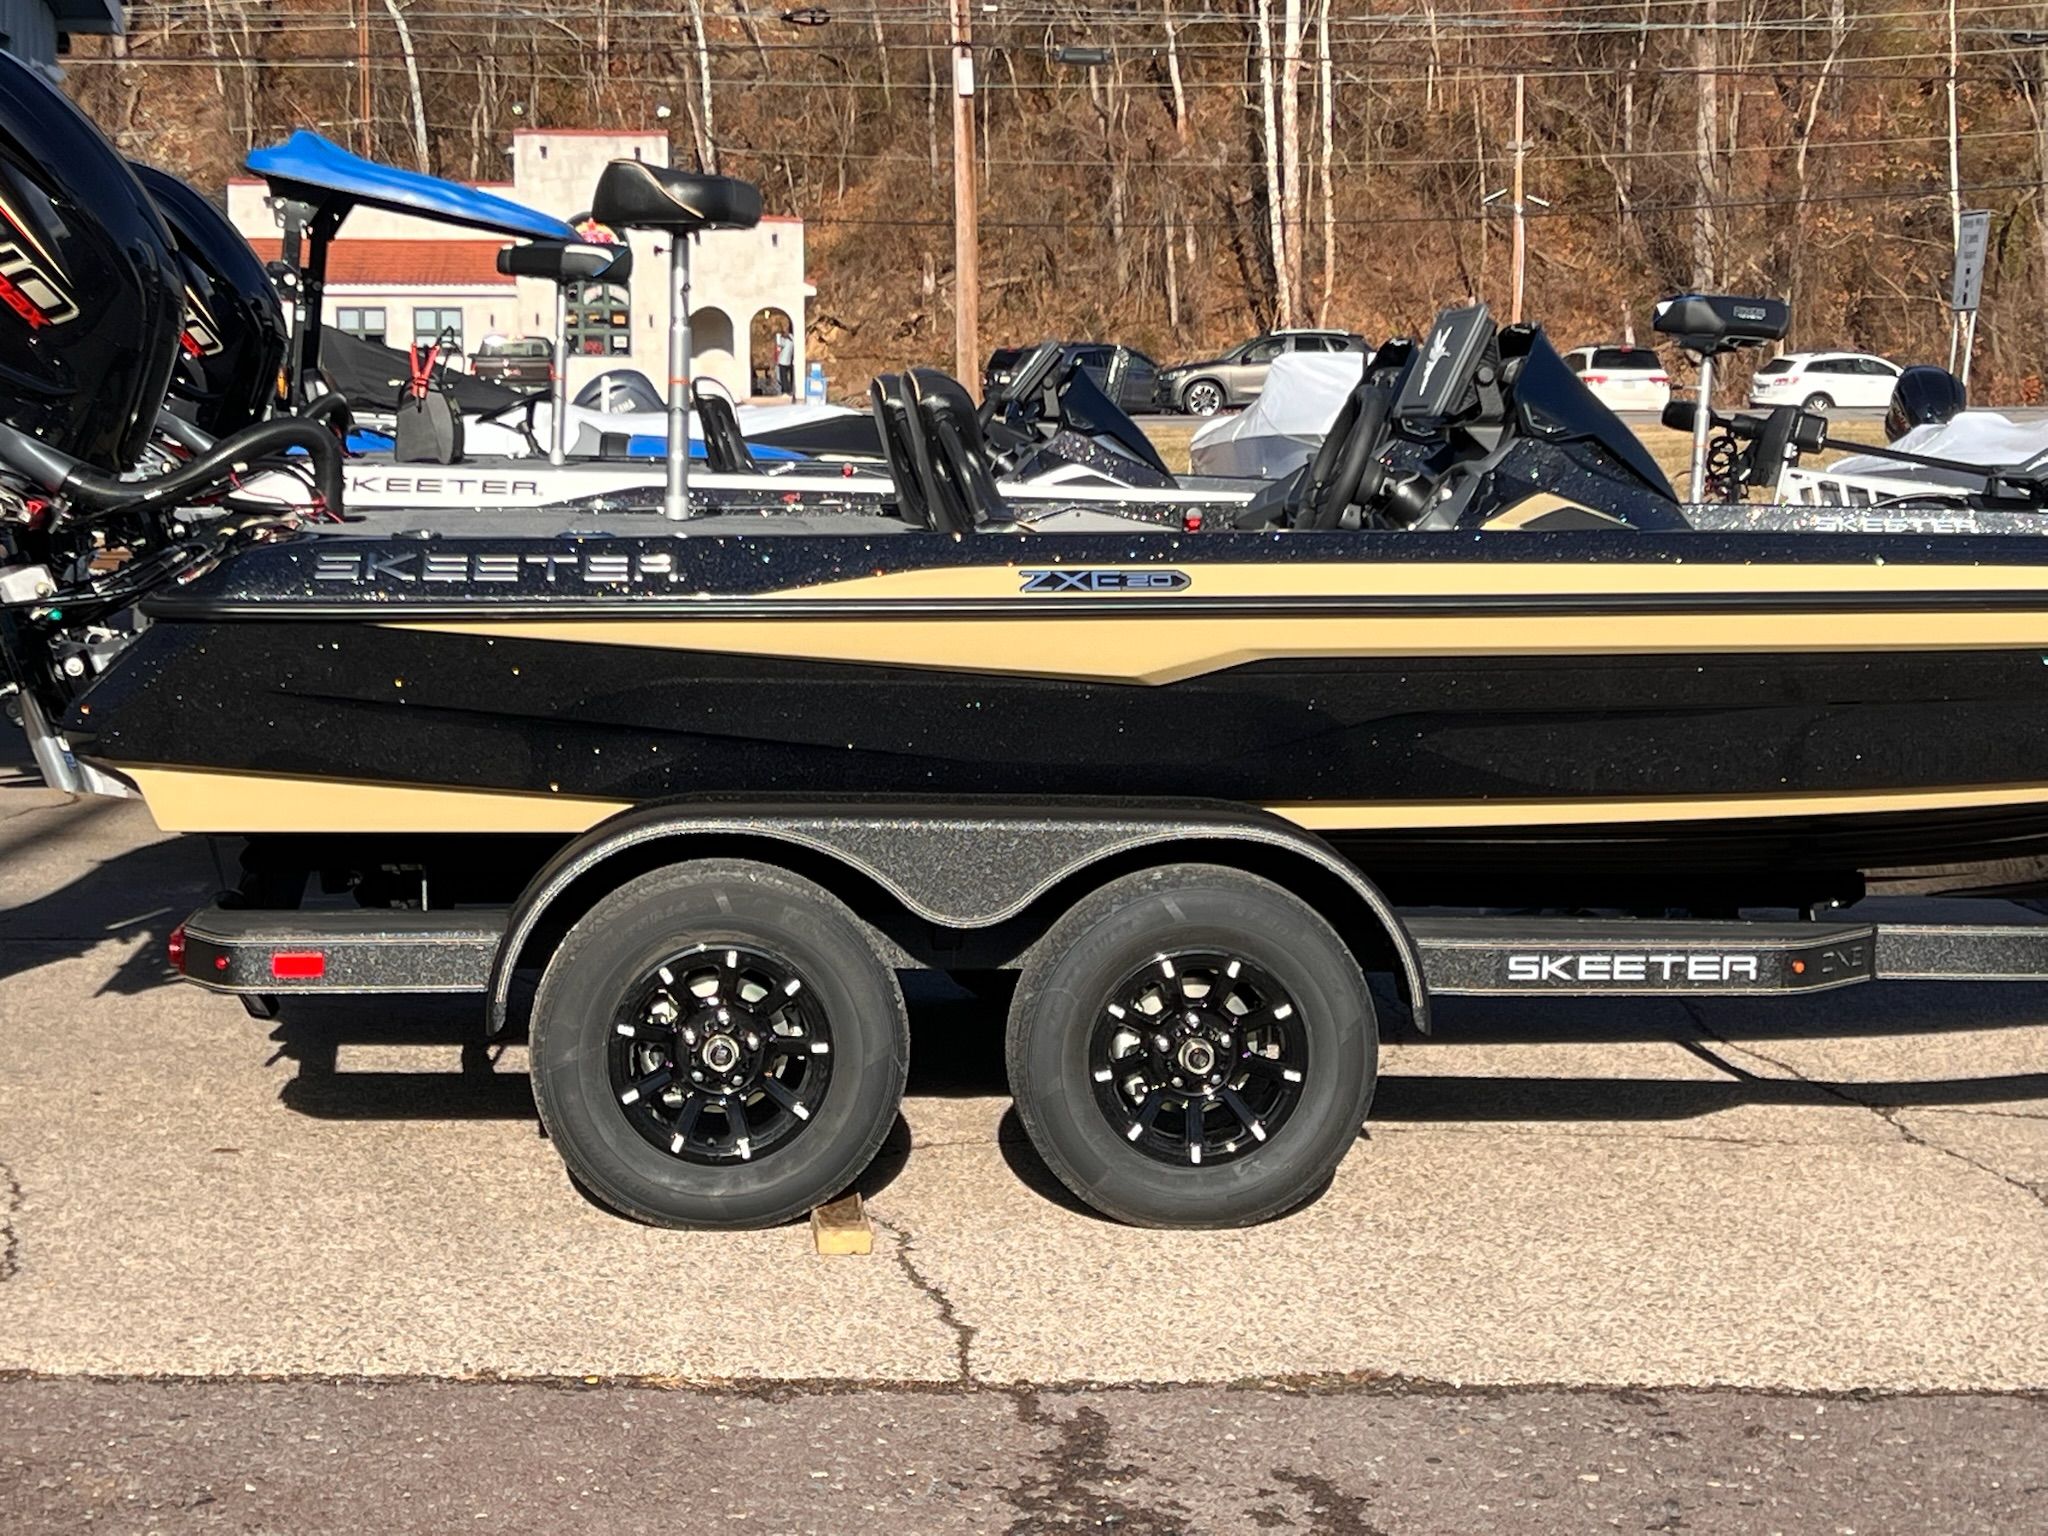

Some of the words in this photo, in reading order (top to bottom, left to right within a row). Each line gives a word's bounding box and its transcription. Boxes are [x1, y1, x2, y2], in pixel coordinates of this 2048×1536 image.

[342, 476, 538, 496] KEETER
[314, 553, 682, 582] SKEETER
[1507, 954, 1759, 982] SKEETER
